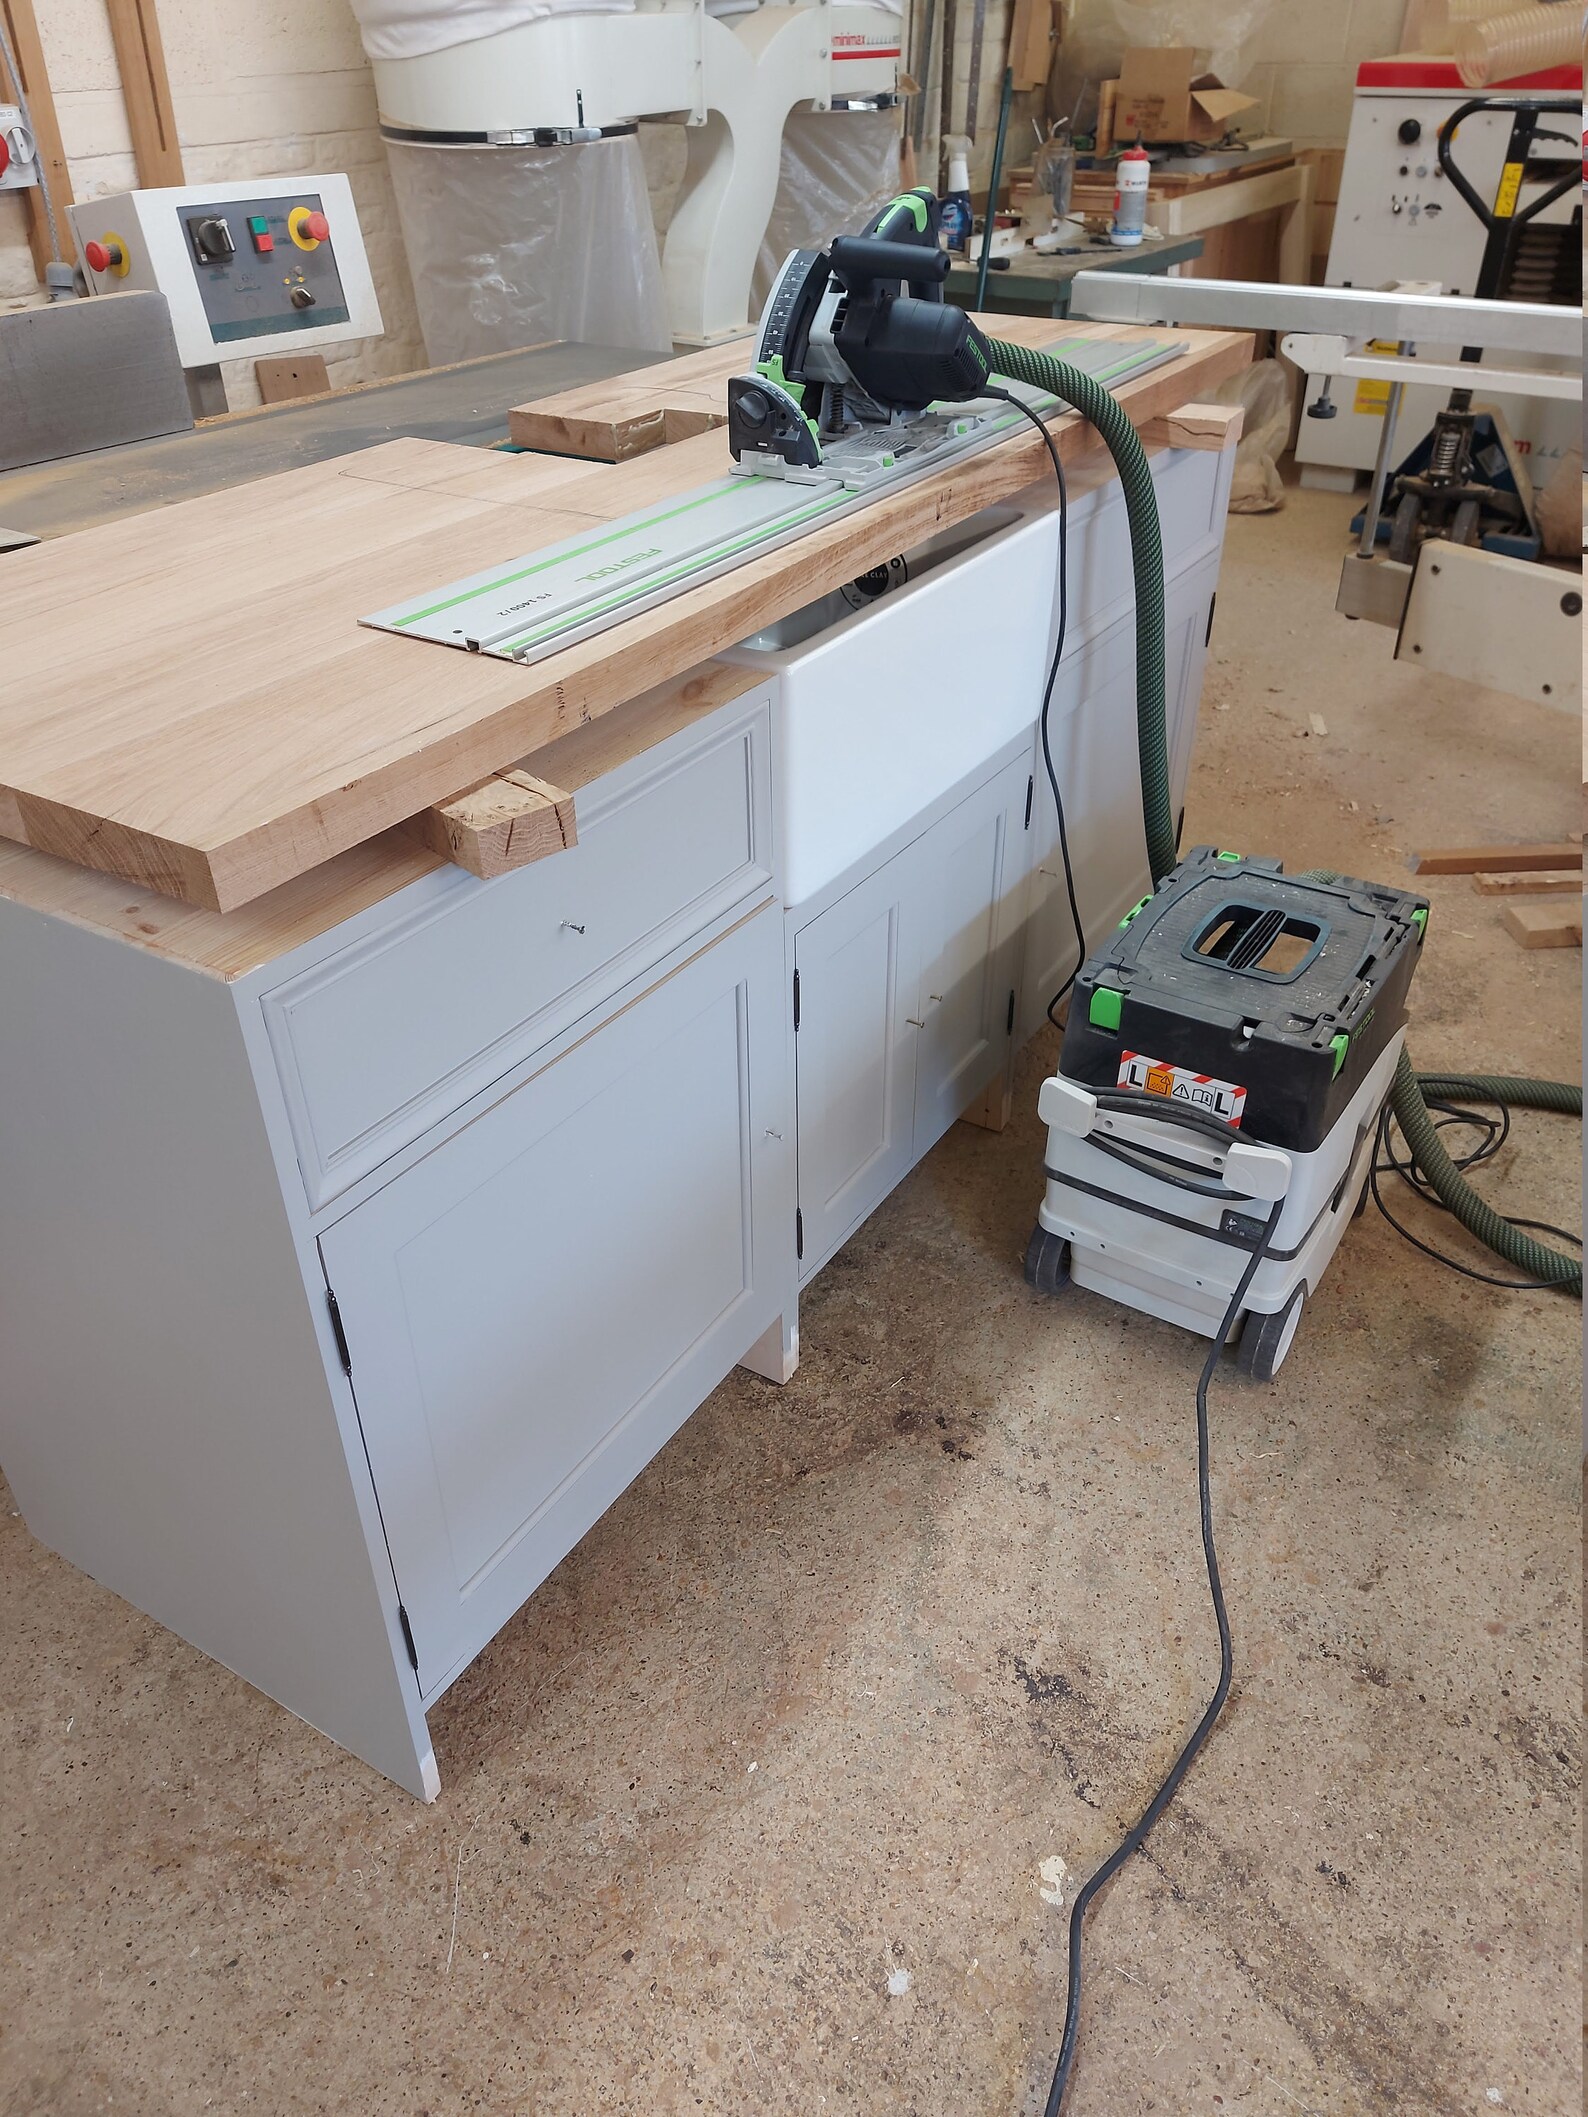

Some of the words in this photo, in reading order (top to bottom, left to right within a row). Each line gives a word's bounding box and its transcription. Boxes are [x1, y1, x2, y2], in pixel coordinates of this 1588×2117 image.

[832, 32, 865, 46] minimax
[966, 334, 987, 374] FESTOOL
[575, 548, 663, 582] FESTOOL
[536, 592, 552, 600] FS
[1128, 1064, 1143, 1088] L
[1214, 1092, 1229, 1116] L
